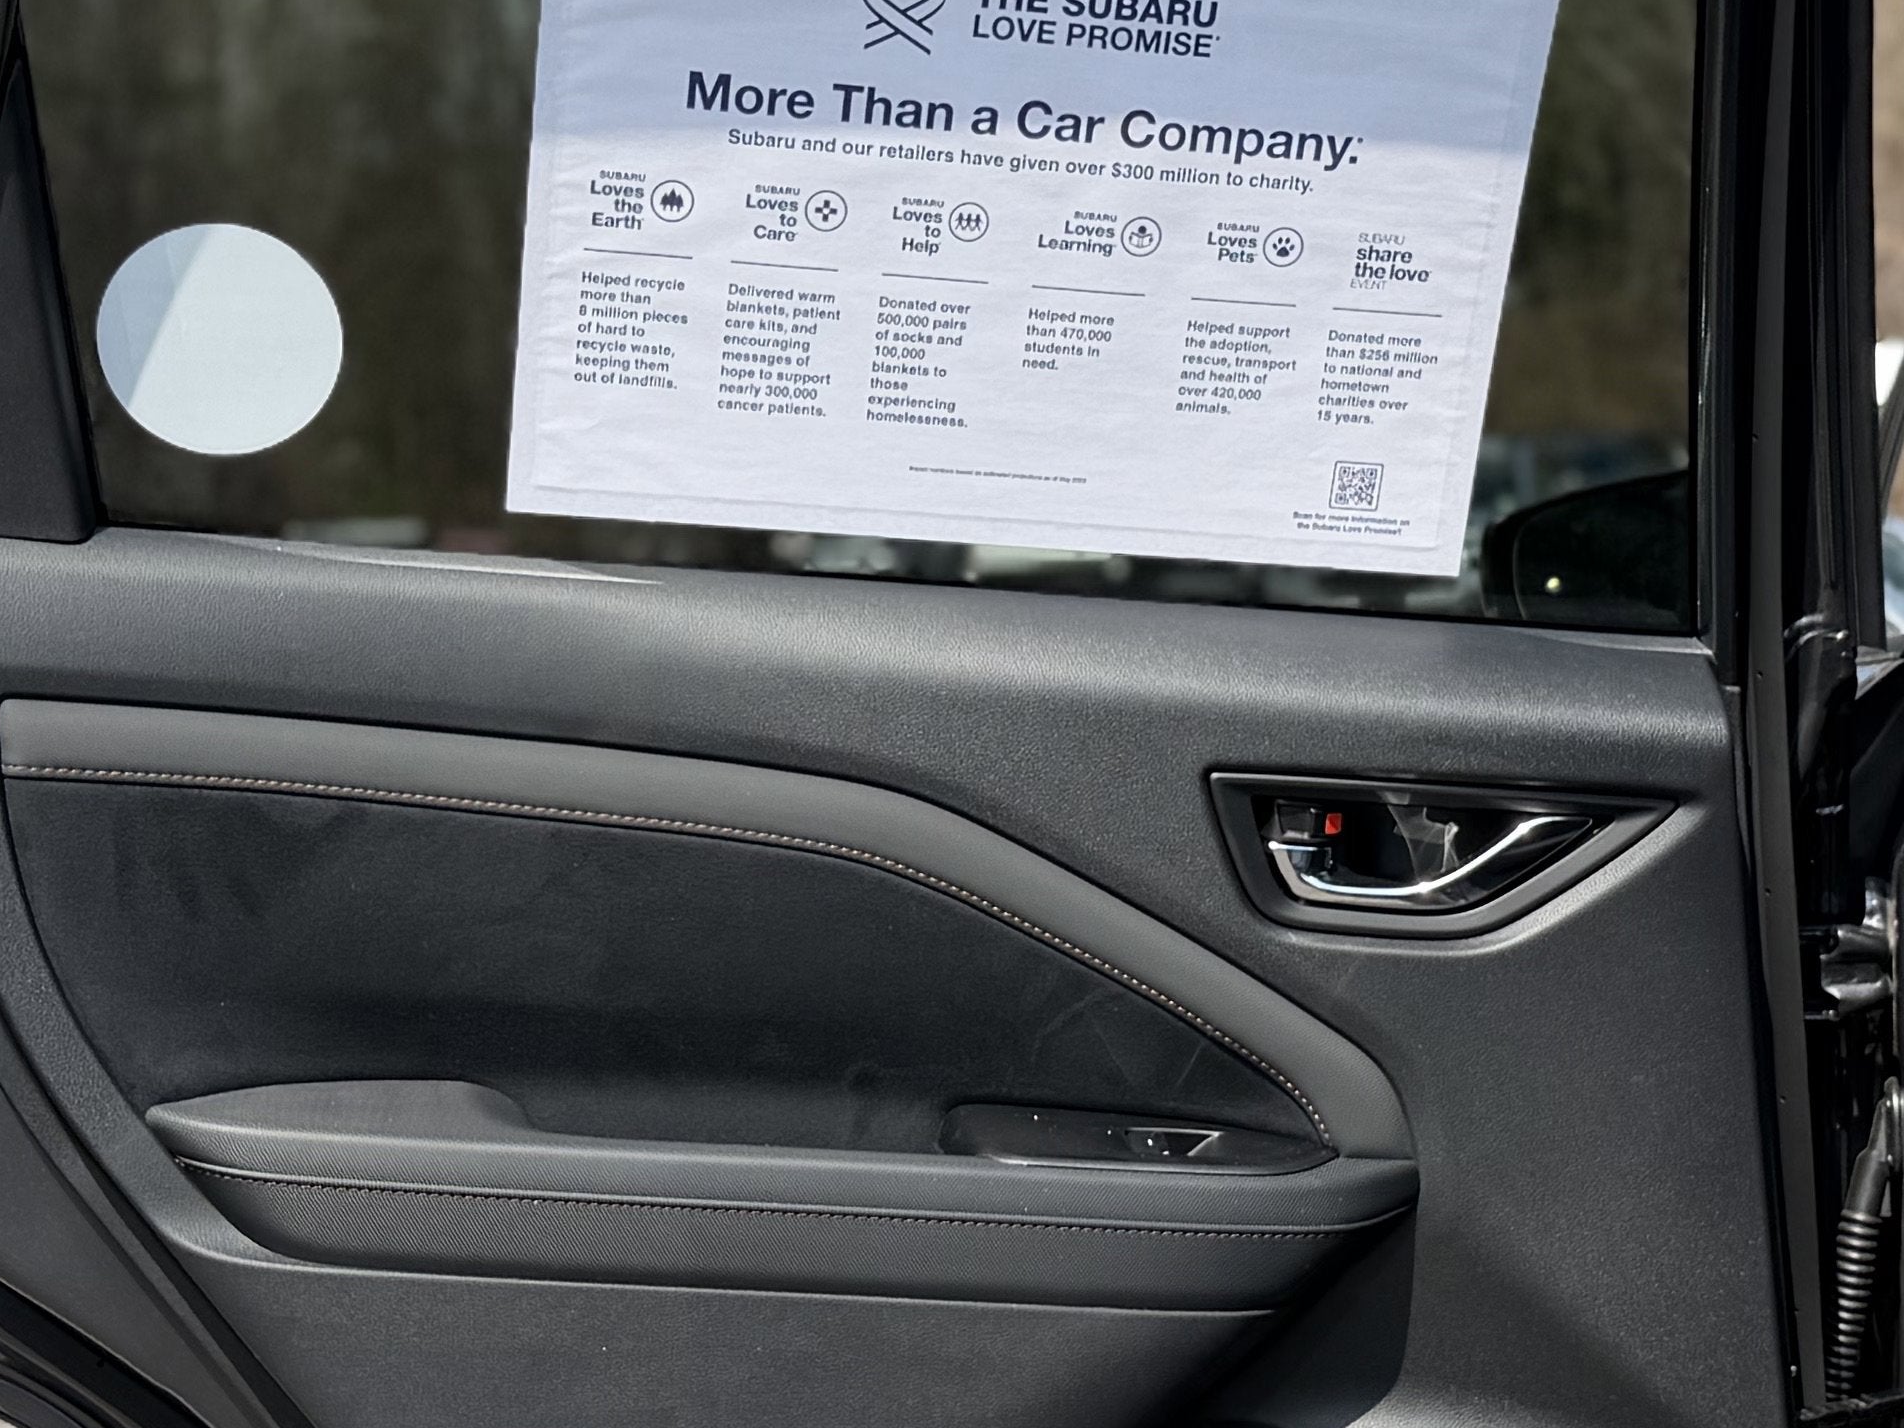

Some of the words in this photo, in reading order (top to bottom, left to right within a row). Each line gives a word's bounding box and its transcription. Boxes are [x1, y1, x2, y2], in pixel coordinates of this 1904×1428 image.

[973, 15, 1056, 44] LOVE
[686, 71, 815, 119] More
[833, 83, 954, 131] Than
[971, 106, 998, 135] a
[1016, 100, 1105, 143] Car
[728, 129, 795, 149] Subaru
[802, 138, 836, 152] and
[842, 142, 873, 156] our
[879, 144, 954, 162] retailers
[960, 150, 1004, 167] have
[1010, 154, 1059, 173] given
[1065, 161, 1105, 176] over
[1111, 163, 1154, 180] $300
[1160, 168, 1219, 185] million
[1227, 173, 1243, 187] to
[1248, 174, 1314, 194] charity.
[599, 170, 646, 182] SUBARU
[590, 180, 645, 198] Loves
[755, 184, 800, 196] SUBARU
[614, 199, 643, 214] the
[746, 194, 798, 212] Loves
[902, 197, 944, 208] SUBARU
[591, 212, 642, 230] Earth
[779, 213, 797, 227] to
[893, 206, 943, 224] Loves
[1074, 211, 1117, 222] SUBARU
[754, 225, 796, 242] Care
[925, 225, 941, 238] to
[1064, 220, 1115, 238] Loves
[902, 237, 939, 256] Help
[1038, 234, 1113, 257] Learning
[1207, 232, 1257, 248] Loves
[1218, 248, 1255, 263] Pets
[1356, 245, 1412, 264] share
[1355, 262, 1386, 279] the
[1389, 264, 1429, 282] love
[582, 271, 631, 287] Helped
[634, 277, 685, 291] recycle
[580, 291, 616, 302] more
[621, 291, 651, 304] than
[728, 283, 793, 300] Delivered
[798, 291, 835, 303] warm
[726, 300, 789, 318] blankets,
[793, 307, 840, 320] patient
[879, 296, 936, 312] Donated
[941, 303, 970, 314] over
[579, 305, 586, 317] 8
[592, 306, 638, 320] million
[643, 310, 688, 324] pieces
[877, 312, 929, 328] 500,000
[933, 318, 966, 331] pairs
[1028, 308, 1076, 323] Helped
[1080, 314, 1114, 326] more
[578, 322, 591, 333] of
[596, 323, 627, 336] hard
[632, 325, 645, 337] to
[725, 319, 755, 330] care
[759, 319, 787, 335] kits,
[791, 323, 817, 335] and
[1027, 324, 1056, 337] than
[1060, 328, 1112, 342] 470,000
[1187, 320, 1234, 335] Helped
[1238, 325, 1290, 338] support
[723, 335, 810, 352] encouraging
[875, 330, 889, 341] of
[893, 332, 933, 344] socks
[937, 334, 962, 346] and
[1185, 336, 1205, 348] the
[1210, 338, 1271, 354] adoption,
[1328, 330, 1384, 345] Donated
[1388, 335, 1421, 347] more
[577, 338, 626, 353] recycle
[631, 344, 675, 358] waste,
[875, 346, 925, 360] 100,000
[1024, 341, 1083, 355] students
[1088, 345, 1099, 357] in
[1326, 346, 1355, 359] than
[1393, 351, 1438, 364] million
[576, 354, 630, 371] keeping
[635, 358, 669, 372] them
[722, 352, 791, 367] messages
[796, 355, 810, 367] of
[1022, 359, 1058, 370] need.
[1182, 354, 1231, 368] rescue,
[1235, 357, 1296, 372] transport
[721, 365, 755, 381] hope
[759, 367, 772, 380] to
[776, 370, 831, 385] support
[872, 361, 929, 376] blankets
[934, 366, 946, 377] to
[1180, 369, 1205, 381] and
[1209, 370, 1249, 383] health
[1254, 373, 1267, 384] of
[1323, 363, 1336, 373] to
[1340, 364, 1393, 377] national
[1397, 368, 1421, 379] and
[574, 372, 596, 382] out
[601, 373, 615, 384] of
[619, 374, 677, 389] landfills.
[870, 377, 908, 391] those
[1321, 378, 1389, 393] hometown
[719, 383, 761, 398] nearly
[765, 385, 817, 400] 300,000
[1178, 386, 1207, 397] over
[1211, 387, 1261, 401] 420,000
[718, 400, 763, 412] cancer
[768, 402, 826, 417] patients.
[868, 395, 956, 413] experiencing
[1176, 401, 1231, 415] animals.
[1318, 395, 1375, 409] charities
[1379, 399, 1408, 411] over
[1317, 410, 1331, 422] 15
[1335, 411, 1374, 425] years.
